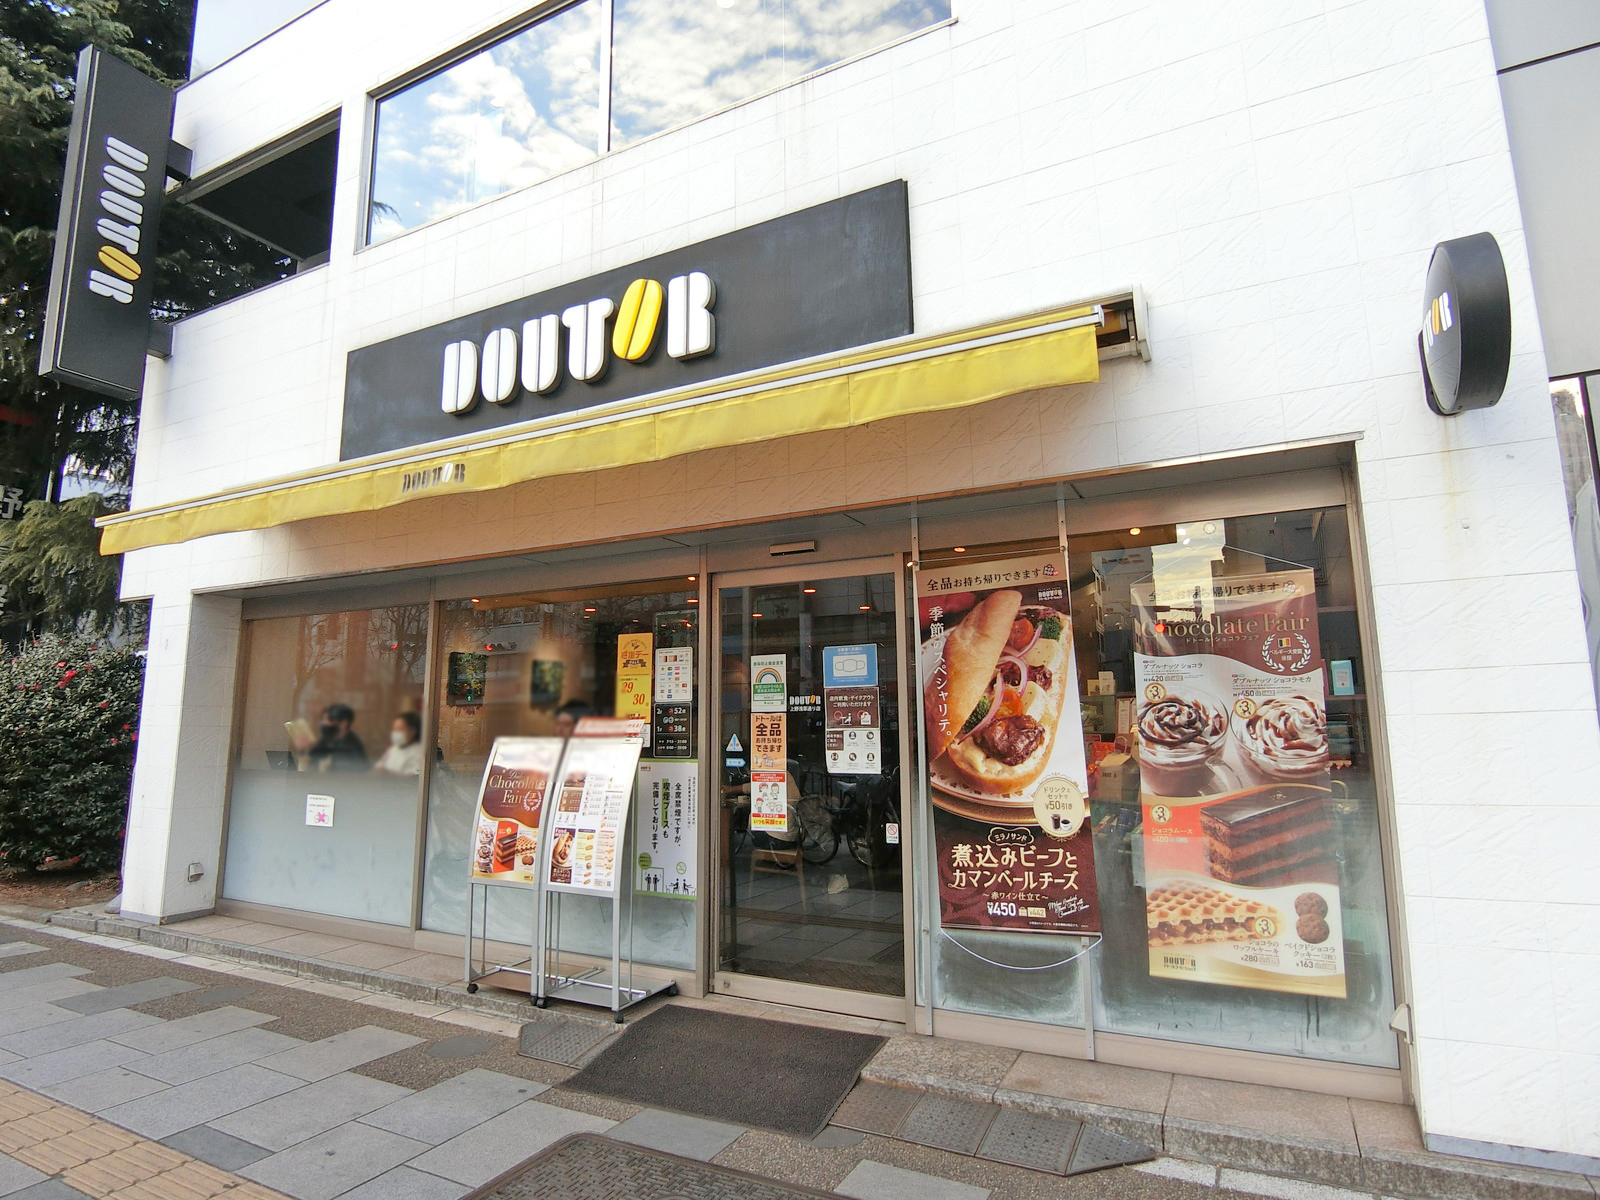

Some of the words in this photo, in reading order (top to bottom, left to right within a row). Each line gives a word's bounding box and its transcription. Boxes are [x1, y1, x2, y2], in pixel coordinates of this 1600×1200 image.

[88, 136, 149, 304] DOUTOR
[441, 271, 716, 414] DOUTOR
[402, 462, 466, 493] DOUTOR
[927, 567, 1042, 592] 全品お持ち帰りできます
[1263, 611, 1310, 632] Fair
[928, 606, 952, 737] 季節のスペシャリテ。
[789, 694, 821, 705] DOUTOR
[755, 722, 782, 736] 全品
[756, 744, 782, 753] できます
[1043, 786, 1071, 795] ドリンクと
[1044, 800, 1073, 811] ¥50引き
[1151, 827, 1193, 835] ショコラムース
[994, 833, 1028, 842] ミラノサンド
[951, 843, 1078, 869] 煮込みビーフと
[947, 869, 1079, 891] カマンベールチーズ
[987, 902, 1016, 917] ¥450
[1233, 944, 1280, 955] ワッフルケーキ
[1248, 940, 1280, 948] ショコラの
[1284, 942, 1336, 953] ベイクドショコラ
[1241, 954, 1258, 963] ¥280
[1296, 960, 1314, 969] ¥163
